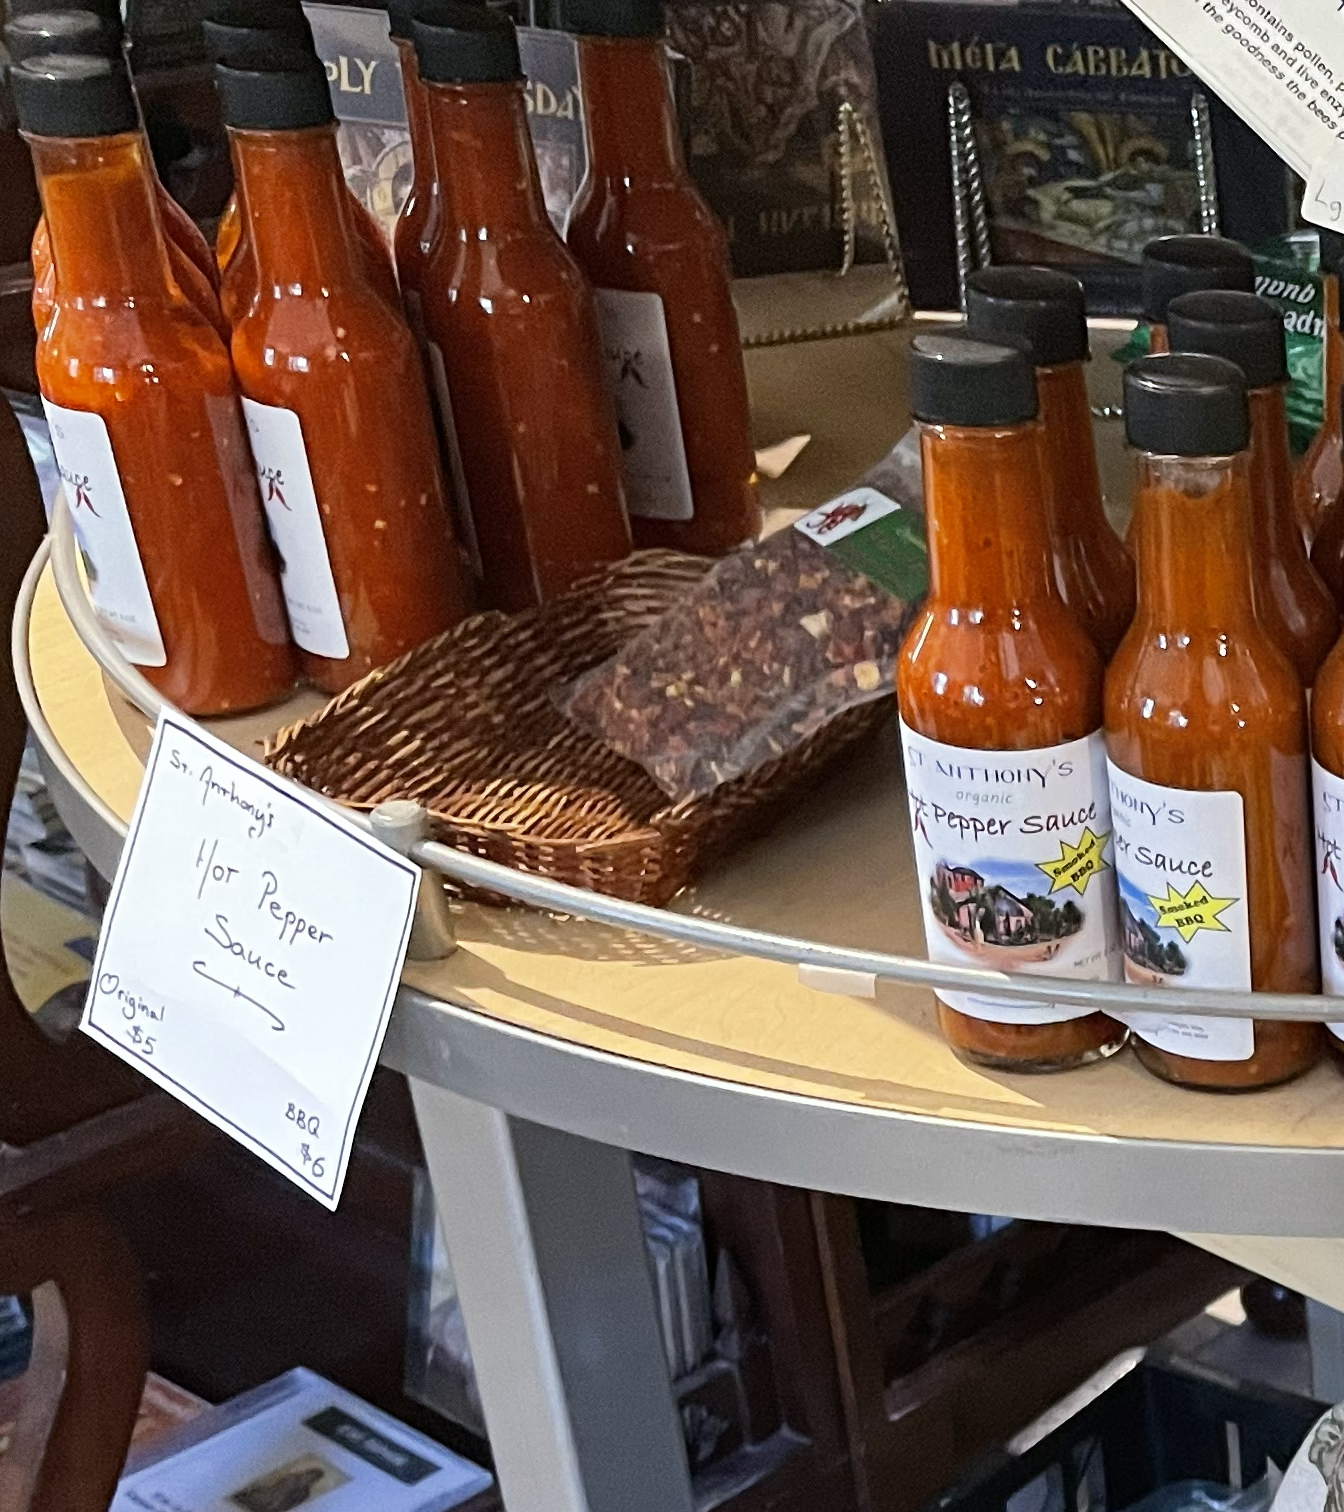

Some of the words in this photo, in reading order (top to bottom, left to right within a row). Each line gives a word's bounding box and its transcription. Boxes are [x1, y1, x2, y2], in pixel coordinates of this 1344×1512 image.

[1245, 0, 1294, 42] ontains
[1293, 41, 1334, 85] pollen,
[1202, 2, 1224, 23] the
[1221, 24, 1285, 80] goodness
[1286, 80, 1307, 101] the
[1307, 98, 1338, 131] bees
[1271, 43, 1298, 68] and
[1296, 63, 1319, 91] live
[935, 759, 1074, 789] ANTHONY'S
[956, 790, 1014, 806] organic
[931, 802, 1012, 842] Pepper
[1019, 802, 1097, 834] Sauce
[1053, 838, 1096, 878] Smoked
[1070, 861, 1094, 883] BBQ
[1134, 846, 1213, 878] Sauce
[257, 871, 333, 946] Pepper
[1159, 895, 1209, 915] Smoked
[1175, 914, 1205, 928] BBQ
[205, 914, 297, 989] Sauce
[99, 972, 166, 1023] Original
[127, 1025, 155, 1056] $5
[286, 1102, 320, 1138] BBQ
[300, 1142, 325, 1178] $6
